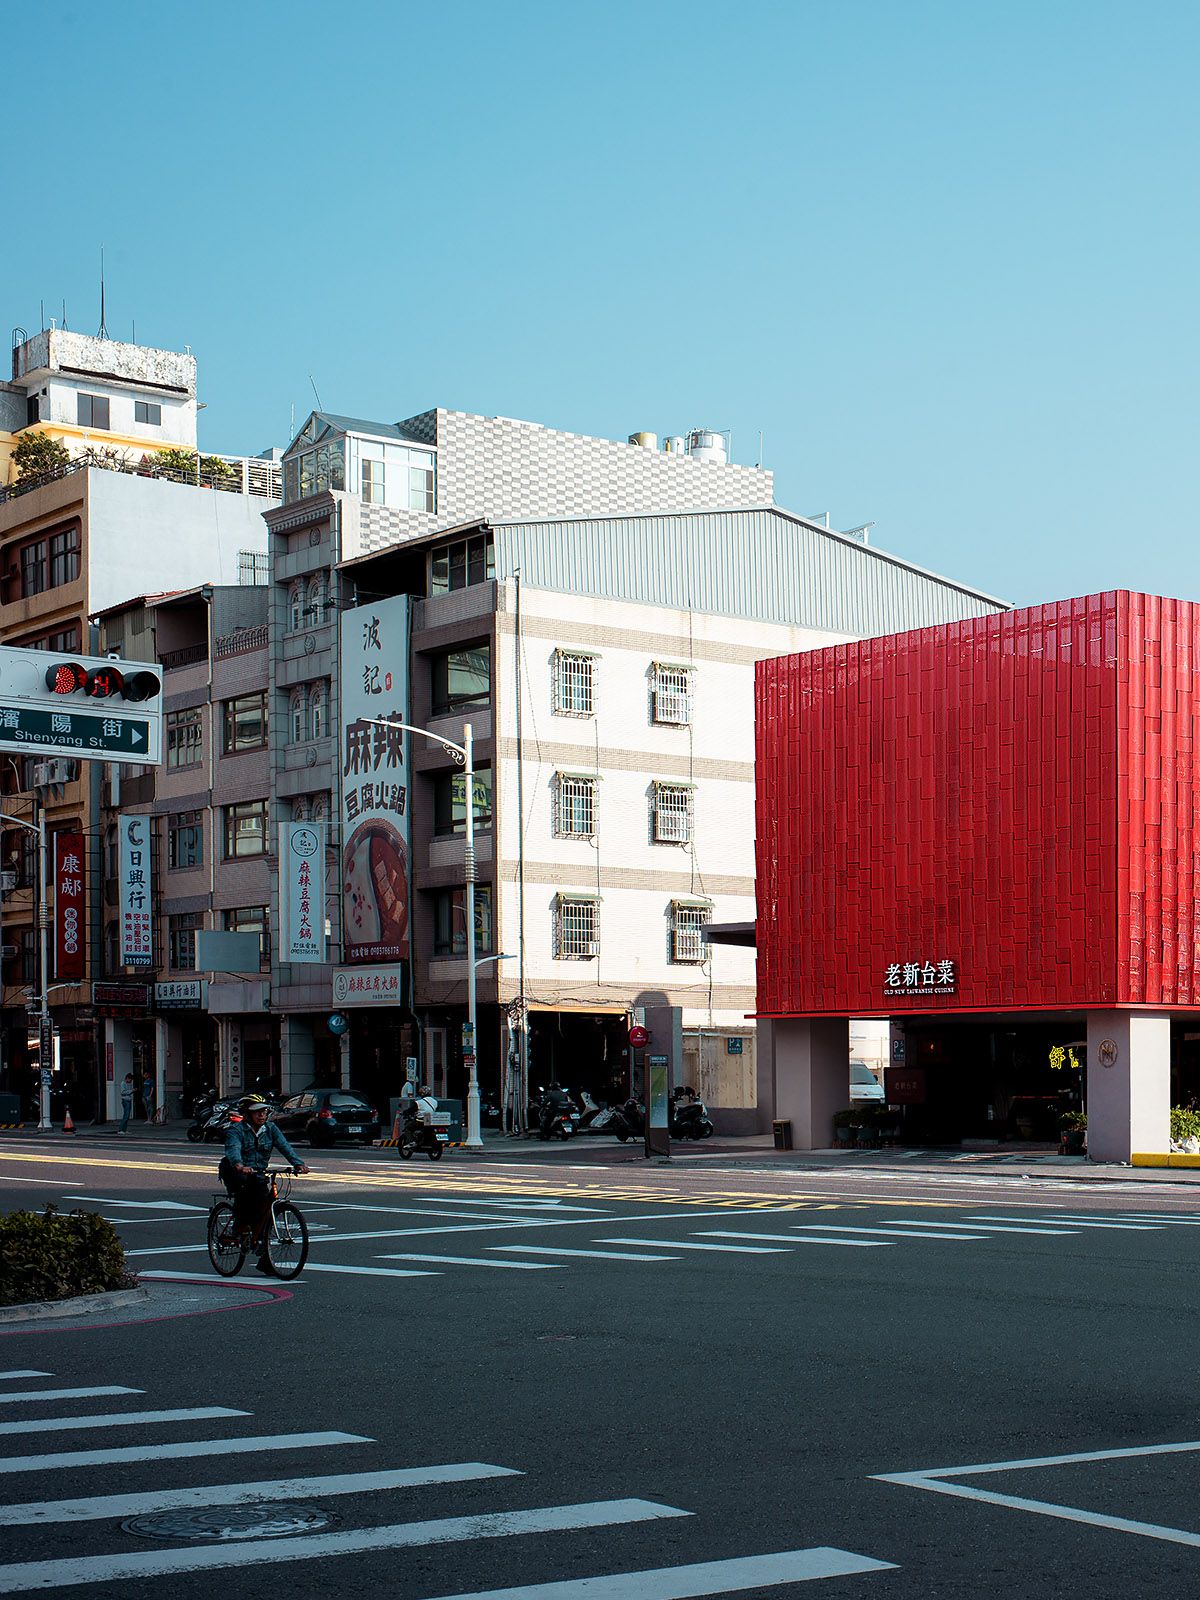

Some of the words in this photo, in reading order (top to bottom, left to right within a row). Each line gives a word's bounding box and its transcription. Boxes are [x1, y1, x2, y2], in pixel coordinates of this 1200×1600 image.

[362, 616, 382, 695] 波記
[15, 730, 83, 747] Shenyang
[89, 736, 107, 748] St.
[344, 710, 403, 777] 麻辣
[344, 780, 406, 823] 豆腐火鍋
[298, 860, 312, 940] 麻辣豆腐火鍋
[125, 957, 150, 965] 3110799
[884, 960, 954, 987] 老新台菜
[349, 976, 398, 992] 麻辣豆腐火鍋
